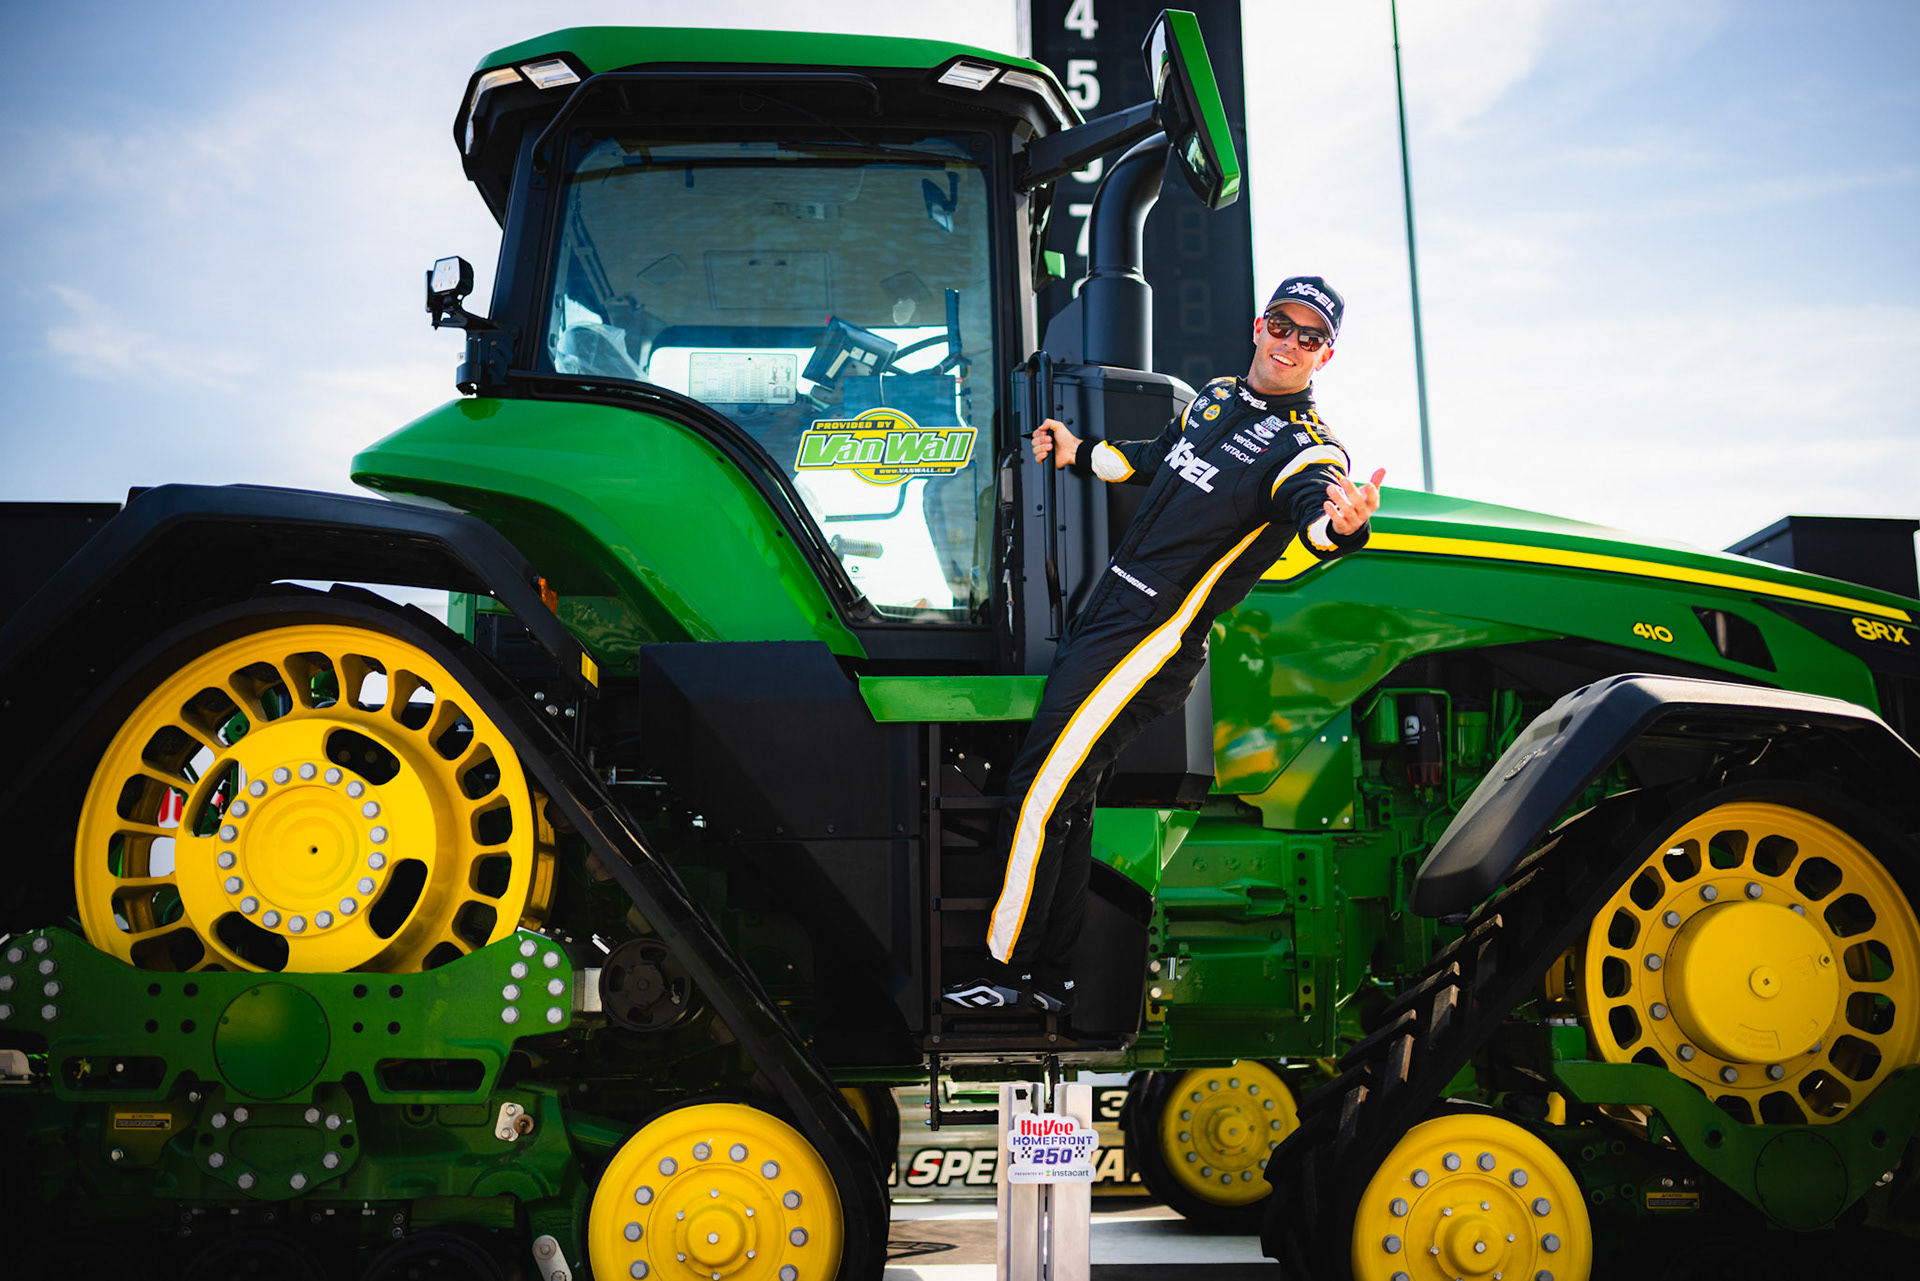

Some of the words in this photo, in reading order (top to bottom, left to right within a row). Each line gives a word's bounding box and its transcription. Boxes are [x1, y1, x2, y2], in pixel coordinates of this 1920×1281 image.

[1064, 0, 1099, 39] 4
[1067, 59, 1101, 110] 5
[1068, 203, 1091, 257] 7
[1287, 282, 1336, 316] XPEL
[1238, 386, 1268, 412] XPEL
[816, 421, 872, 430] PROVIDED
[876, 420, 892, 429] BY
[1220, 442, 1256, 465] HITACHI
[1233, 433, 1262, 454] verizon
[1164, 436, 1220, 494] XPEL
[1632, 622, 1674, 643] 410
[1851, 617, 1911, 645] 8RX
[1013, 1136, 1093, 1146] HOMEFRONT
[1032, 1147, 1073, 1165] 250
[1052, 1169, 1089, 1177] instacart
